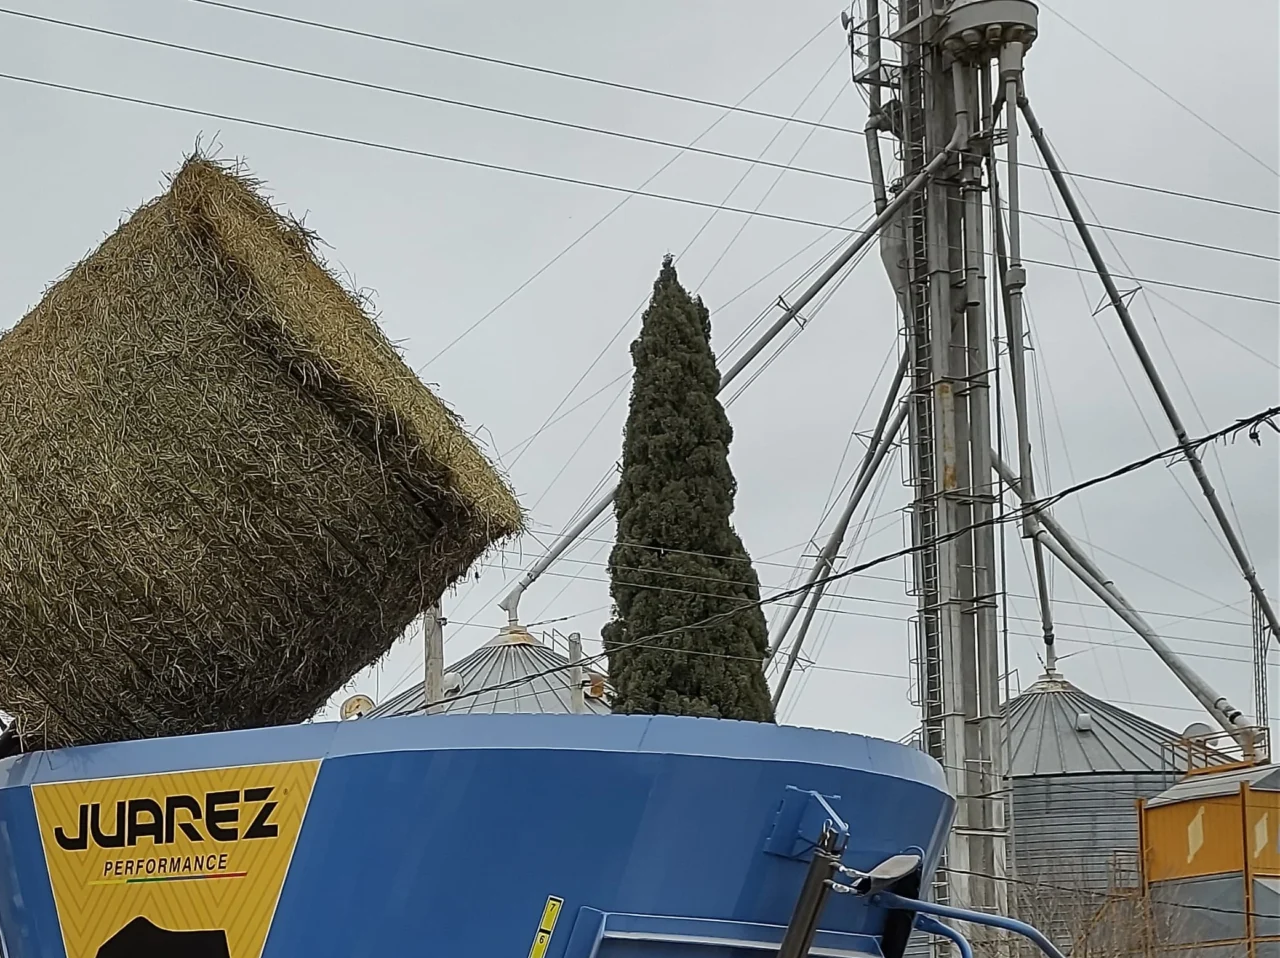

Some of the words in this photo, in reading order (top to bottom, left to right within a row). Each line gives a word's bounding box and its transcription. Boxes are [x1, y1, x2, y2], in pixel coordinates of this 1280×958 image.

[54, 786, 278, 850] JUAREZ
[103, 853, 228, 877] PERFORMANCE
[549, 903, 556, 912] 7
[539, 935, 545, 944] 6
